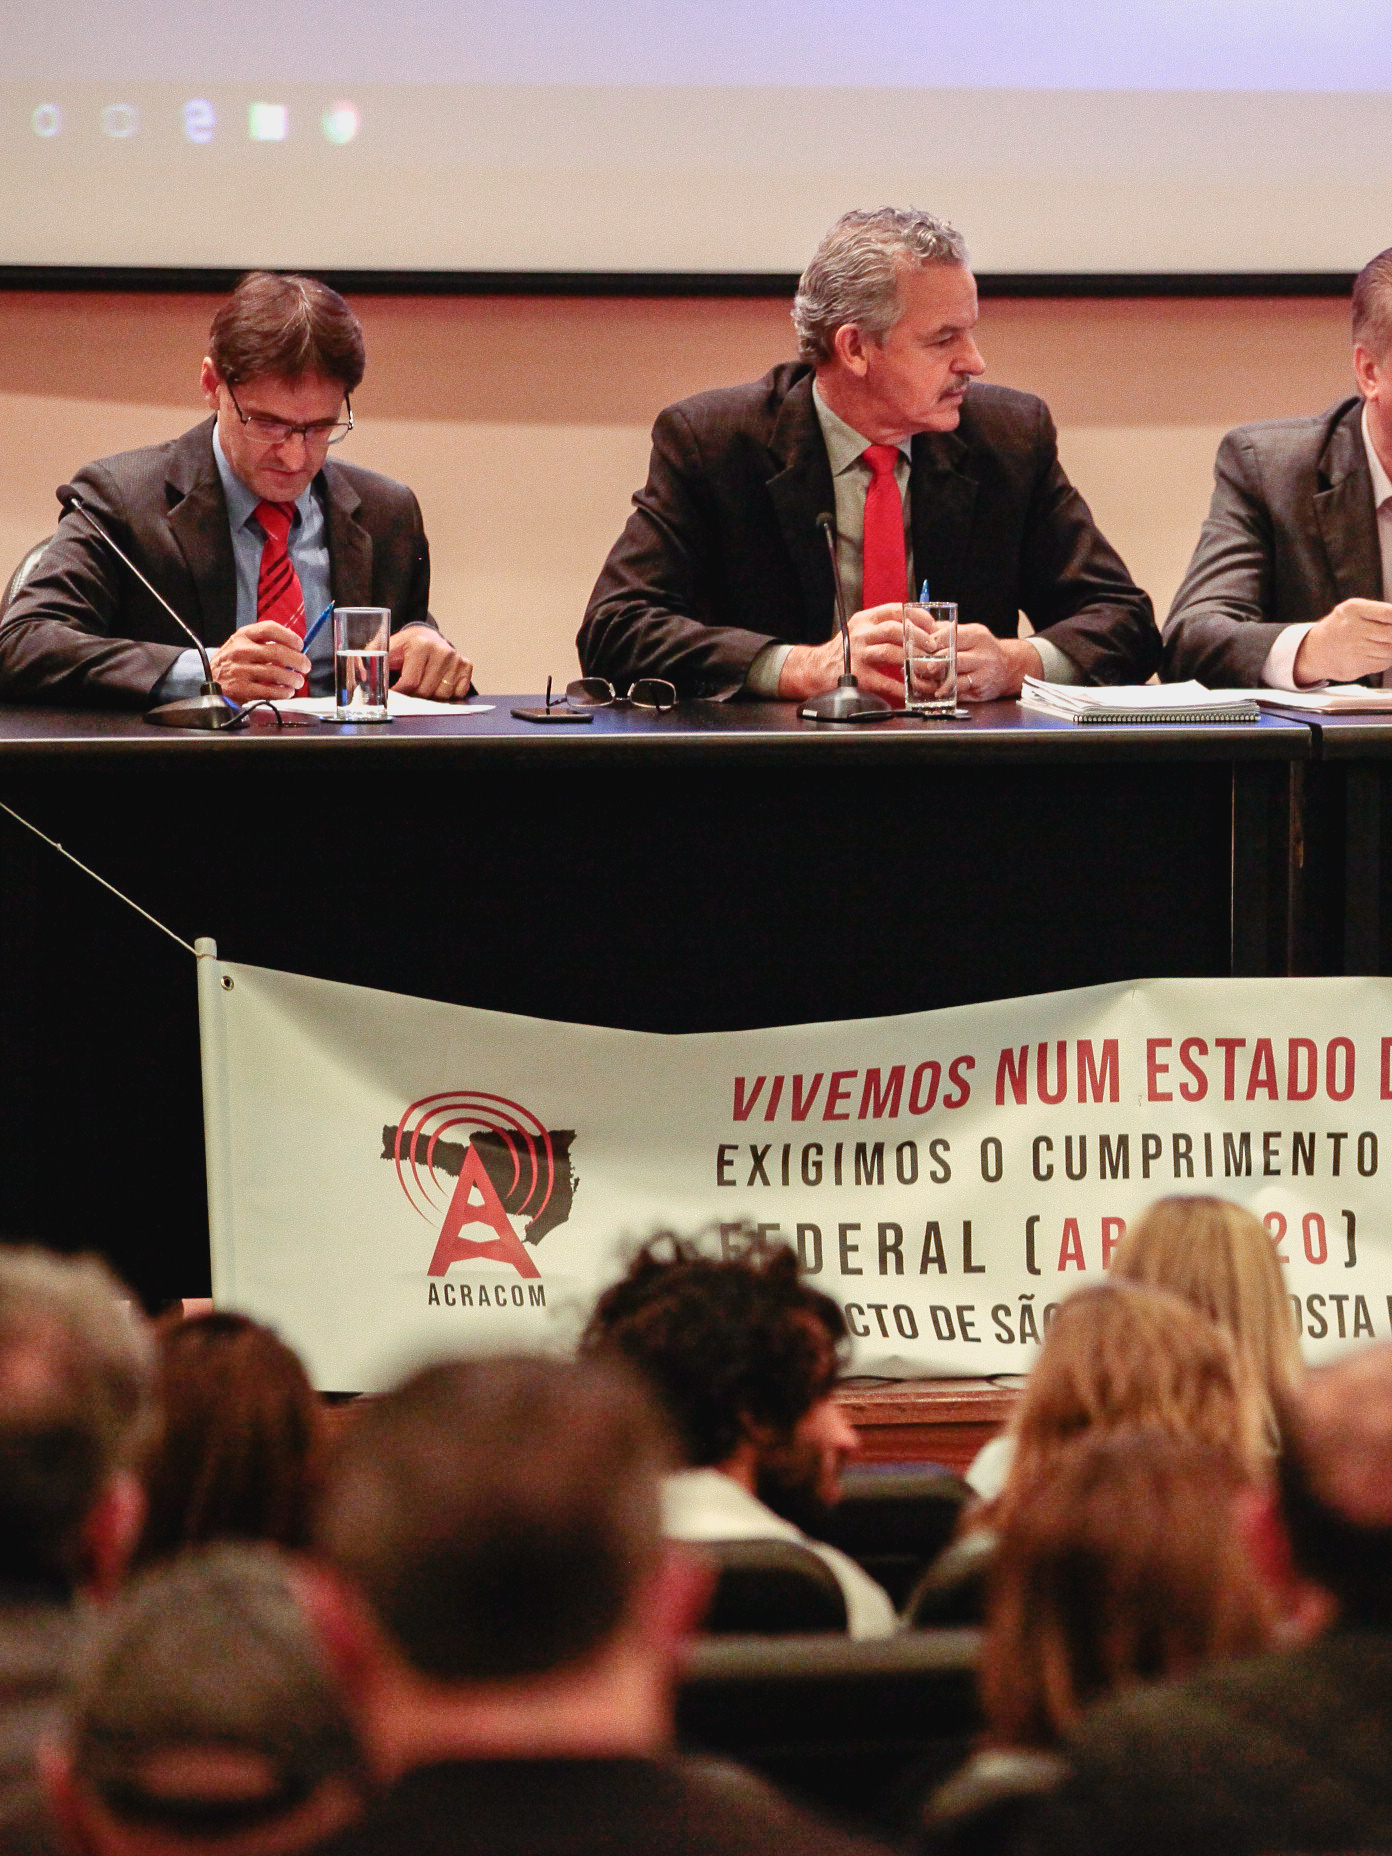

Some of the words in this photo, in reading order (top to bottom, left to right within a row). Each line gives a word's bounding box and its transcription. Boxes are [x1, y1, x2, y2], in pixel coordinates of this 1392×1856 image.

[732, 1054, 976, 1123] VIVEMOS
[995, 1038, 1120, 1106] NUM
[1146, 1036, 1356, 1103] ESTADO
[716, 1137, 952, 1187] EXIGIMOS
[980, 1136, 1004, 1184] O
[1032, 1130, 1379, 1182] CUMPRIMENTO
[428, 1282, 547, 1307] ACRACOM
[844, 1302, 920, 1340] CTO
[929, 1304, 982, 1343] DE
